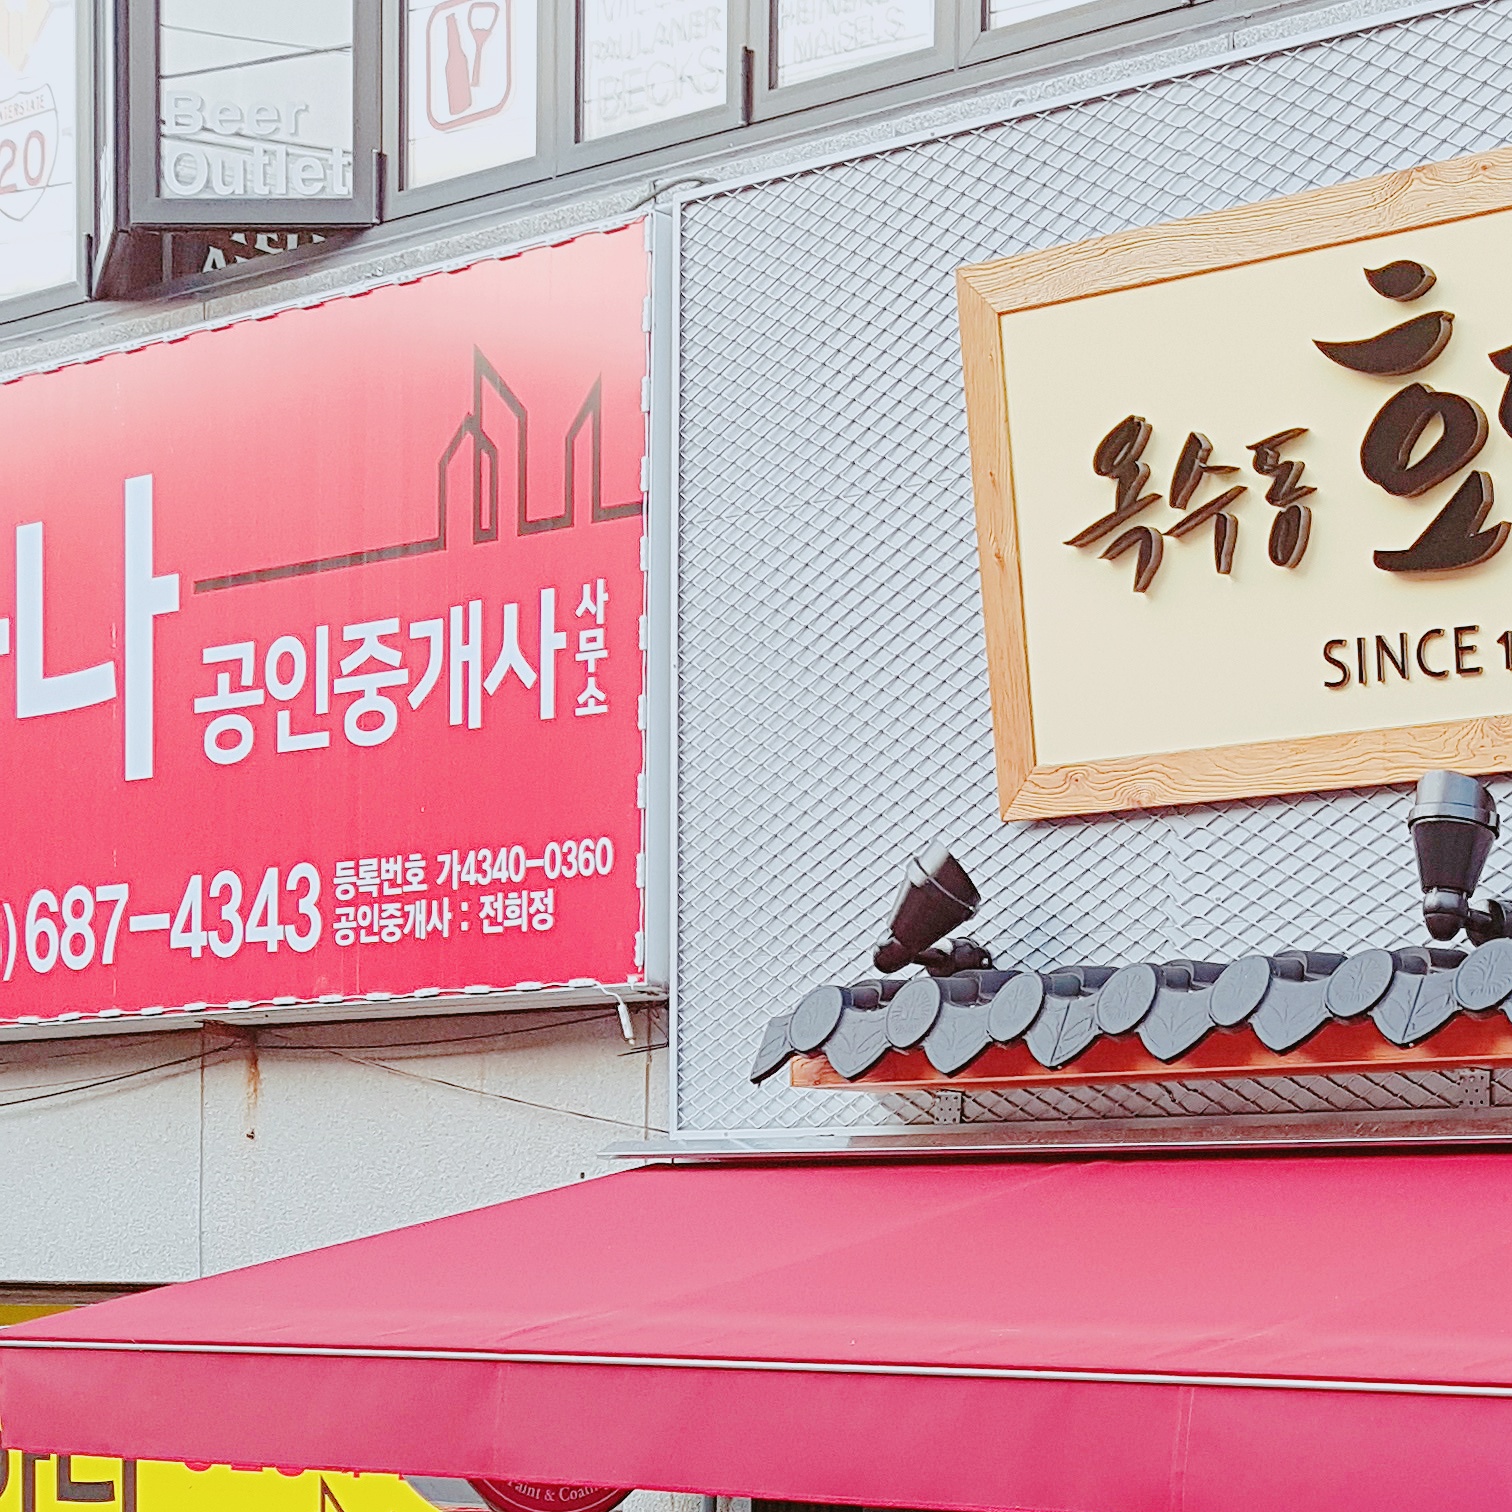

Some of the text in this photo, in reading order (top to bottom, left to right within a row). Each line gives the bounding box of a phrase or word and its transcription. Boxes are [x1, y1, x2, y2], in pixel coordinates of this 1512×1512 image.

[166, 90, 309, 136] Beer
[164, 144, 351, 195] Outlet
[1063, 413, 1318, 595] 옥수동
[0, 473, 180, 781] 나
[574, 577, 609, 718] 사무소
[1322, 624, 1482, 690] SINCE
[194, 587, 567, 766] 공인중개사
[333, 836, 613, 900] 등록번호 가4340-0360
[333, 898, 452, 947] 공인중개사
[478, 890, 555, 935] 전희정
